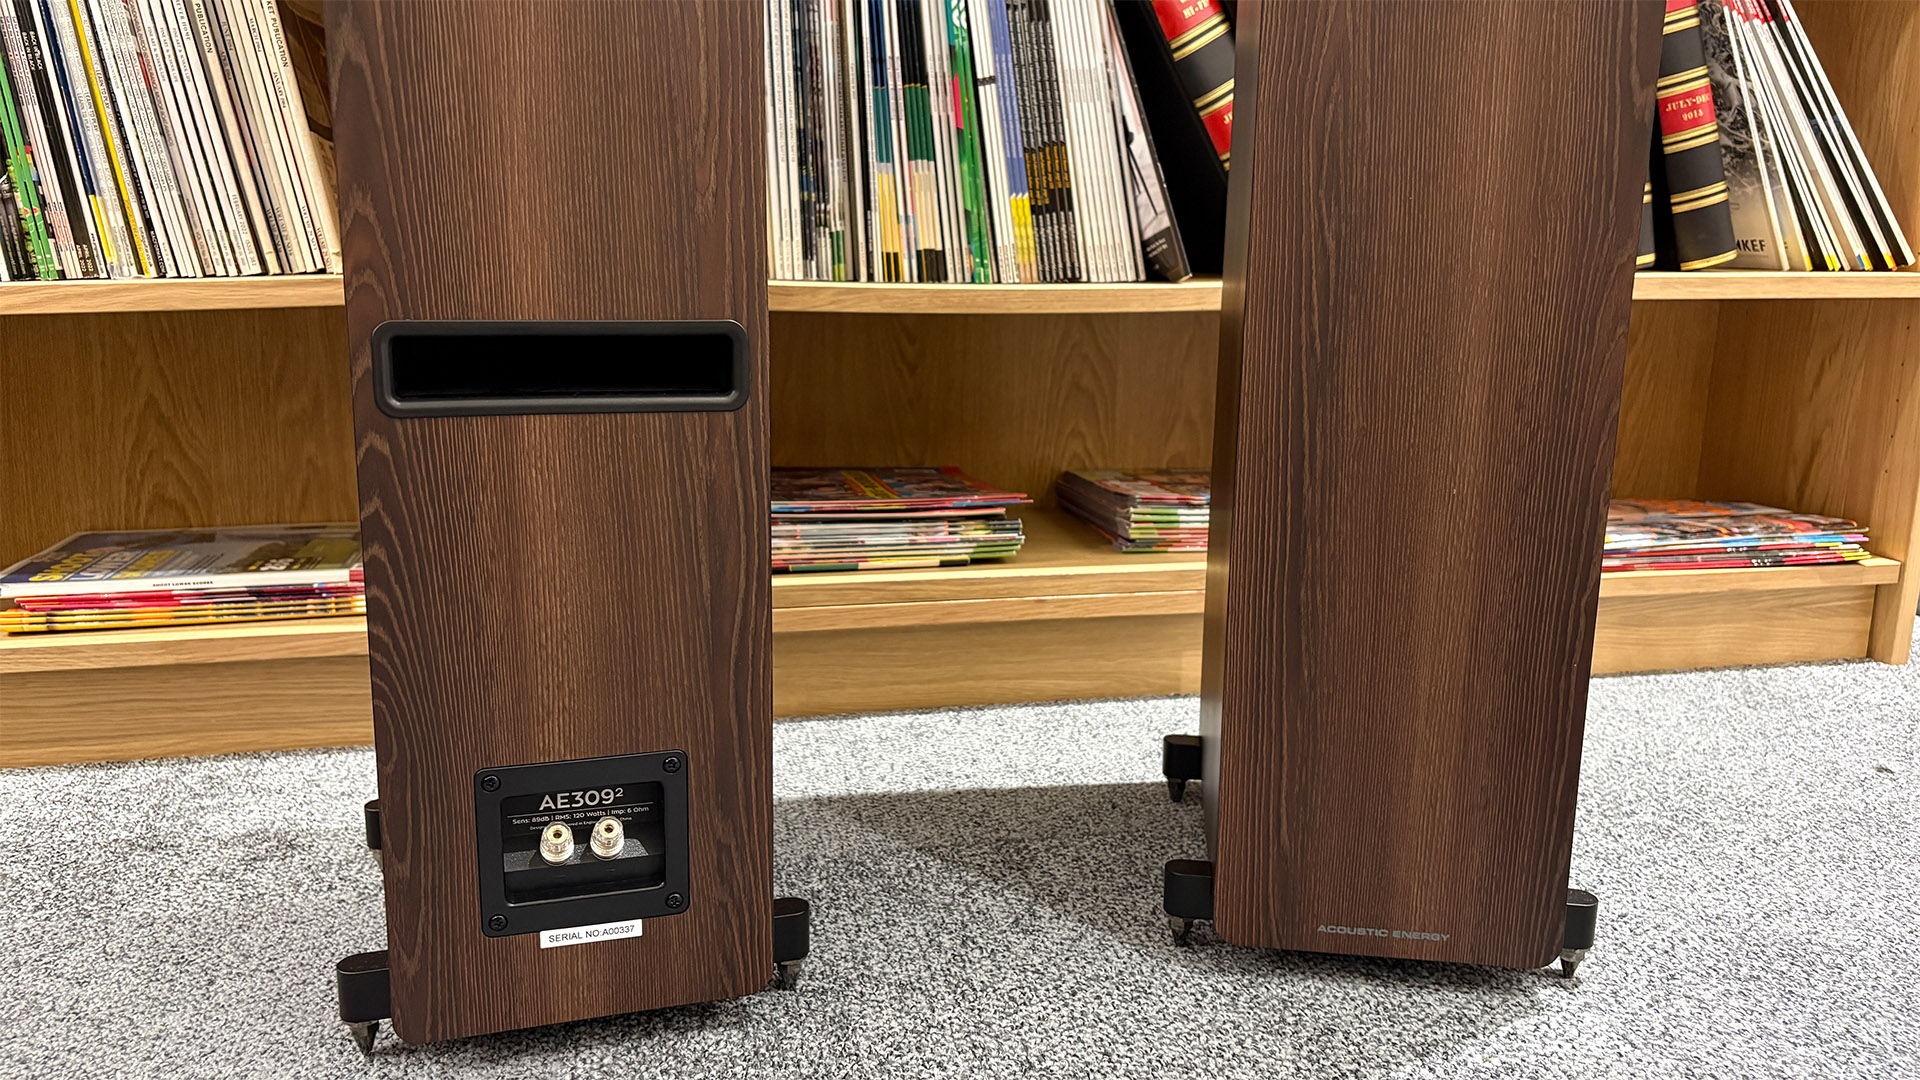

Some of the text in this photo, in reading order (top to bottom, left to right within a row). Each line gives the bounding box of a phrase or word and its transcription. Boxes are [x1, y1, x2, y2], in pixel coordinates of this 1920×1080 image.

[194, 2, 213, 54] PUBLICATION
[270, 16, 289, 68] PUBLICATION
[512, 818, 531, 826] Sens:
[611, 808, 626, 816] Imp:
[548, 933, 583, 943] SERIAL
[1317, 924, 1450, 941] ACOUSTIC ENERGY
